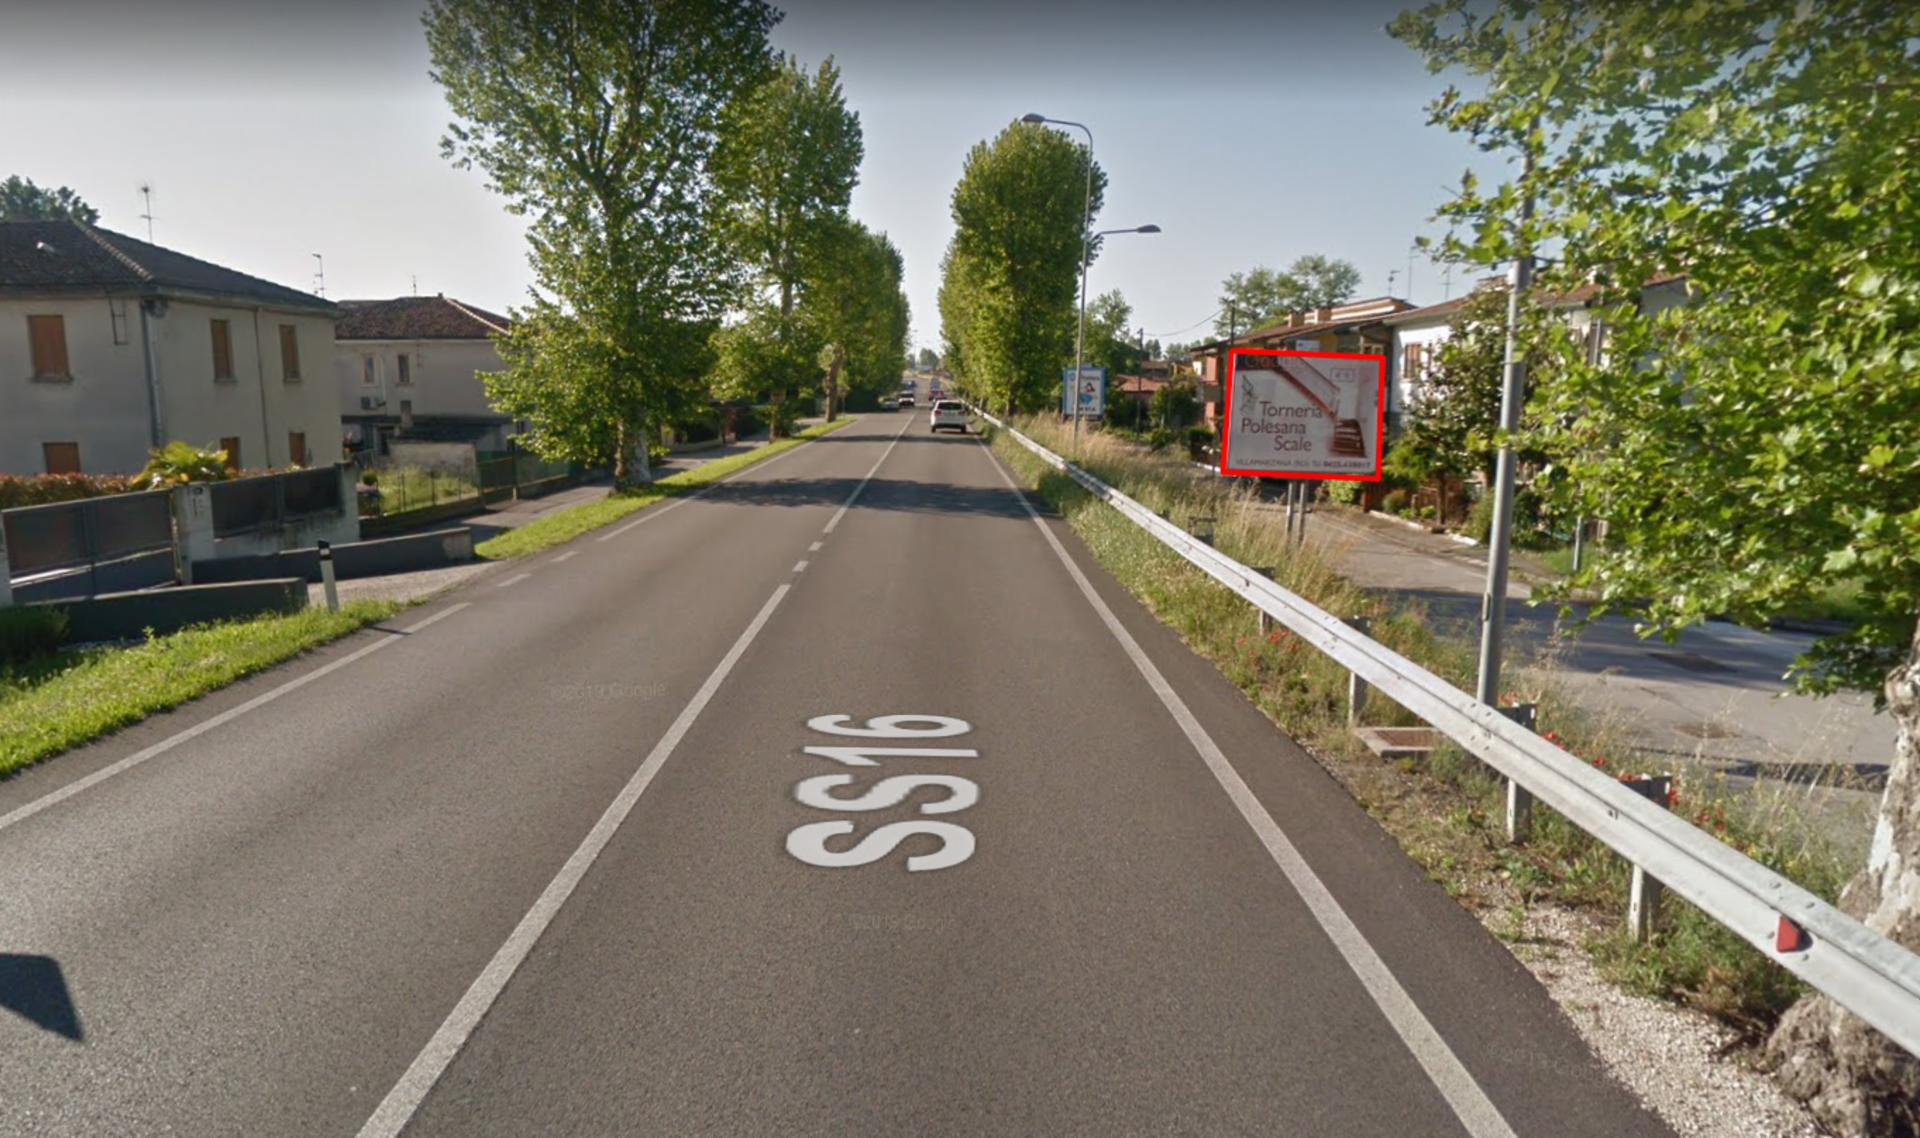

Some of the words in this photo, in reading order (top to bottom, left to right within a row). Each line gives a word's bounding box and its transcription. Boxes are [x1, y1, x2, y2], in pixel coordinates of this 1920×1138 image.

[1259, 401, 1322, 418] Torneria
[1241, 418, 1306, 435] Polesana
[1274, 435, 1312, 452] Scale
